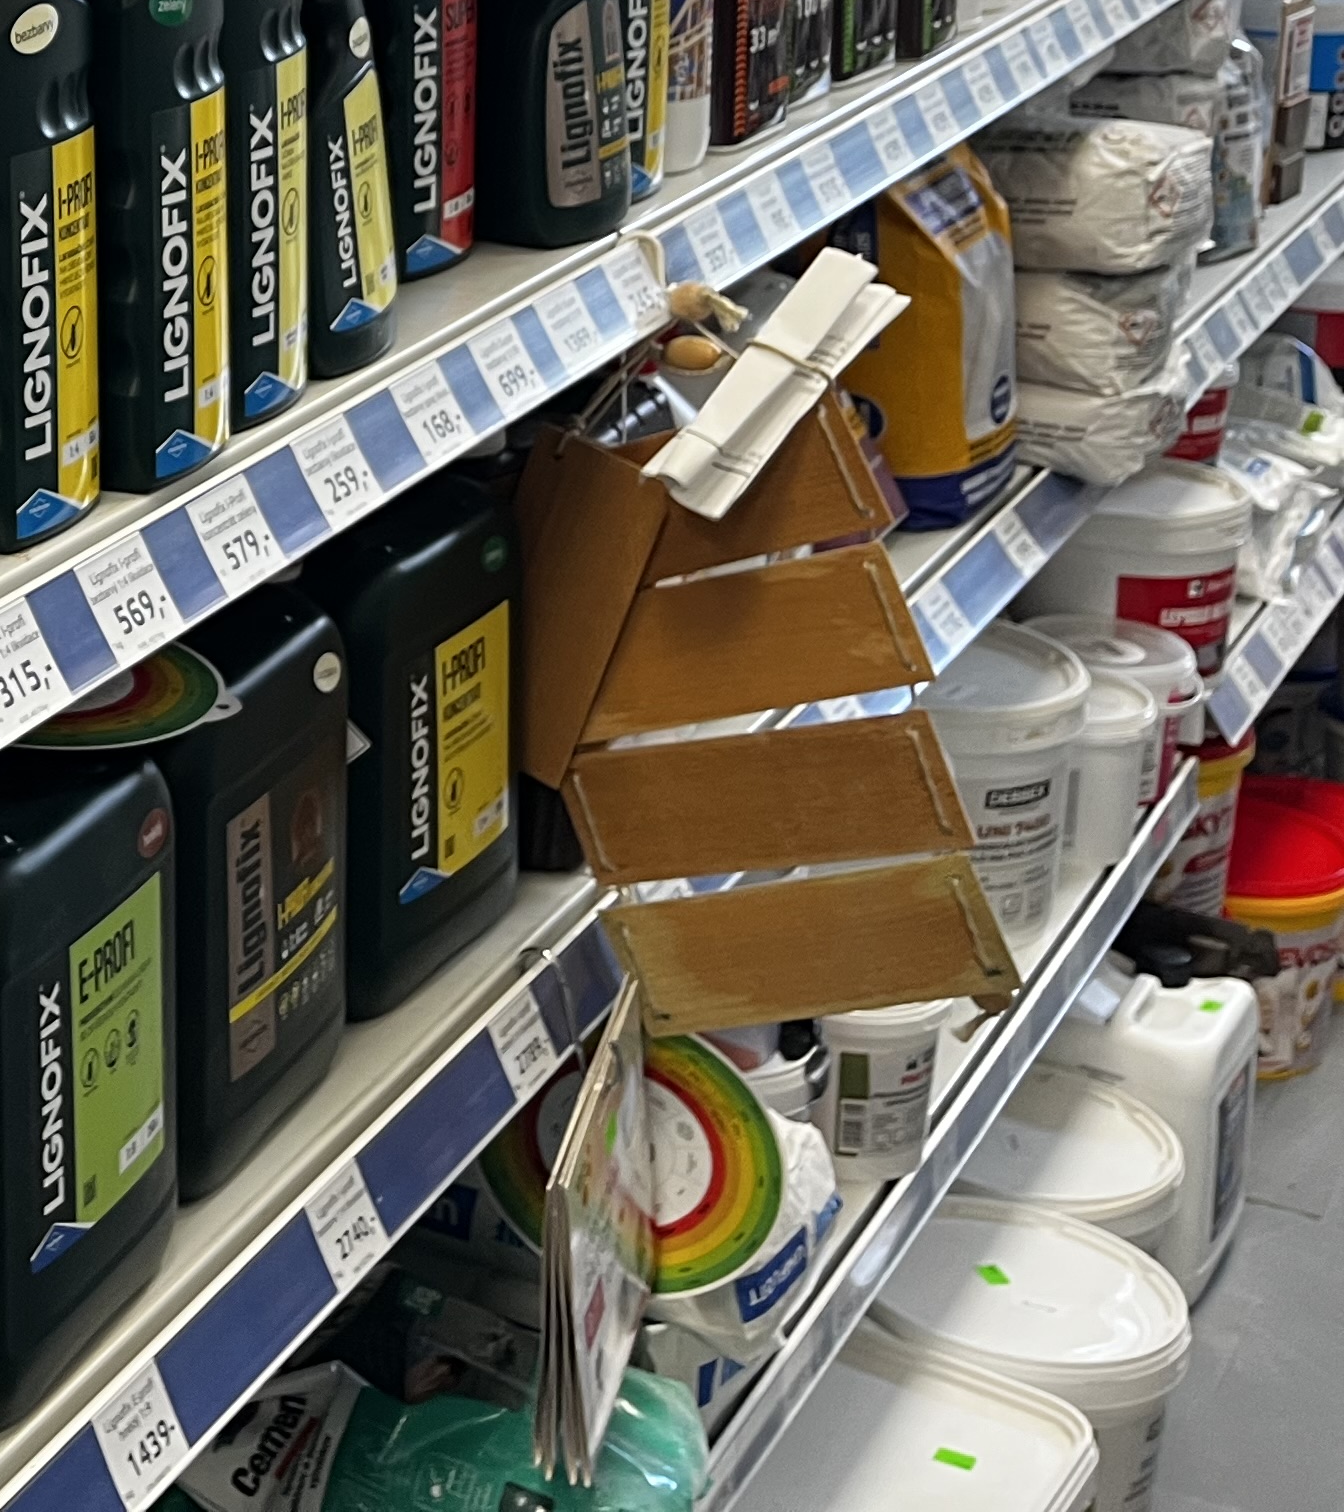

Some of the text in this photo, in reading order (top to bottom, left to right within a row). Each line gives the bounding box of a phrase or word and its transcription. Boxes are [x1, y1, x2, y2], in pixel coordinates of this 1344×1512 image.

[15, 18, 54, 45] bezbarvý
[413, 7, 438, 214] LIGNOFIX
[248, 106, 275, 347] LIGNOFIX
[328, 138, 356, 288] LIGNOFIX
[19, 192, 52, 461] LIGNOFIX
[160, 147, 188, 403] LIGNOFIX
[421, 409, 464, 444] 168,-
[497, 366, 538, 397] 699,-
[323, 466, 372, 505] 259,-
[221, 529, 272, 572] 579,-
[113, 590, 168, 636] 569,-
[410, 673, 428, 861] LIGNOFIX
[77, 917, 136, 1005] E-PROFI
[39, 981, 66, 1216] LIGNOFIX
